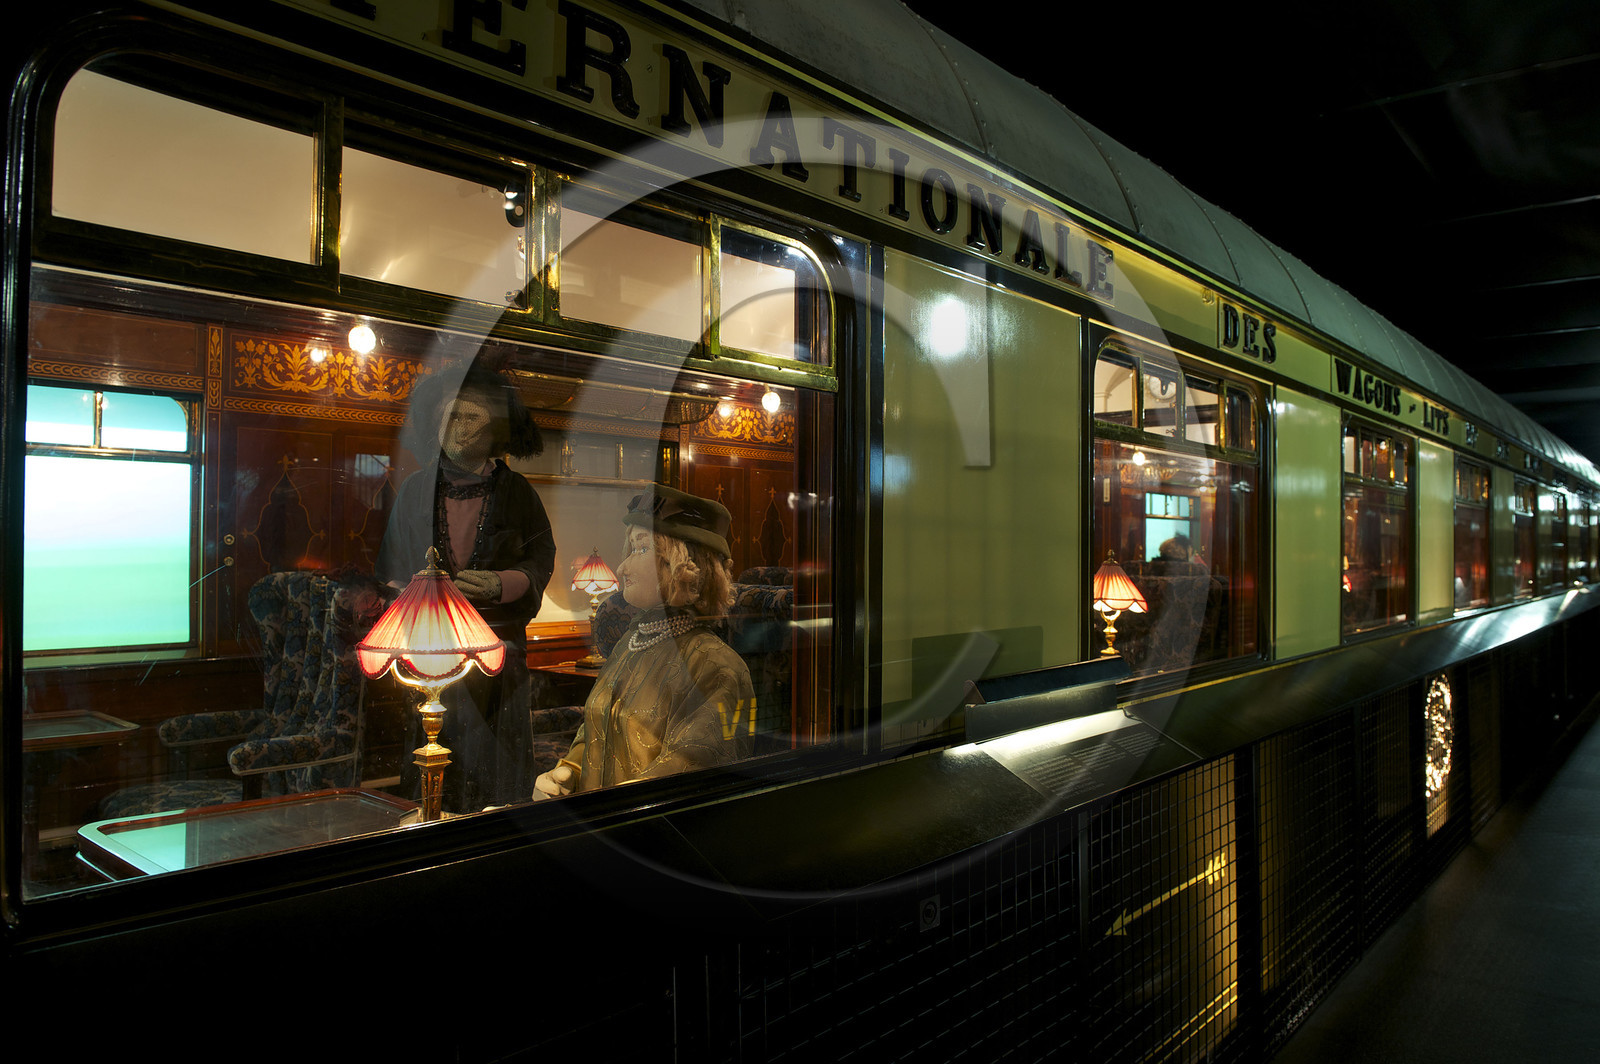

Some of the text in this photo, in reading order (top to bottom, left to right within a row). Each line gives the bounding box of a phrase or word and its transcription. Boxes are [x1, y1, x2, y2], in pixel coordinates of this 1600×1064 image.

[331, 0, 1114, 301] ERNATIONALE
[1223, 303, 1277, 364] DES
[1335, 358, 1401, 416] WAGONS
[1423, 400, 1450, 436] LITS
